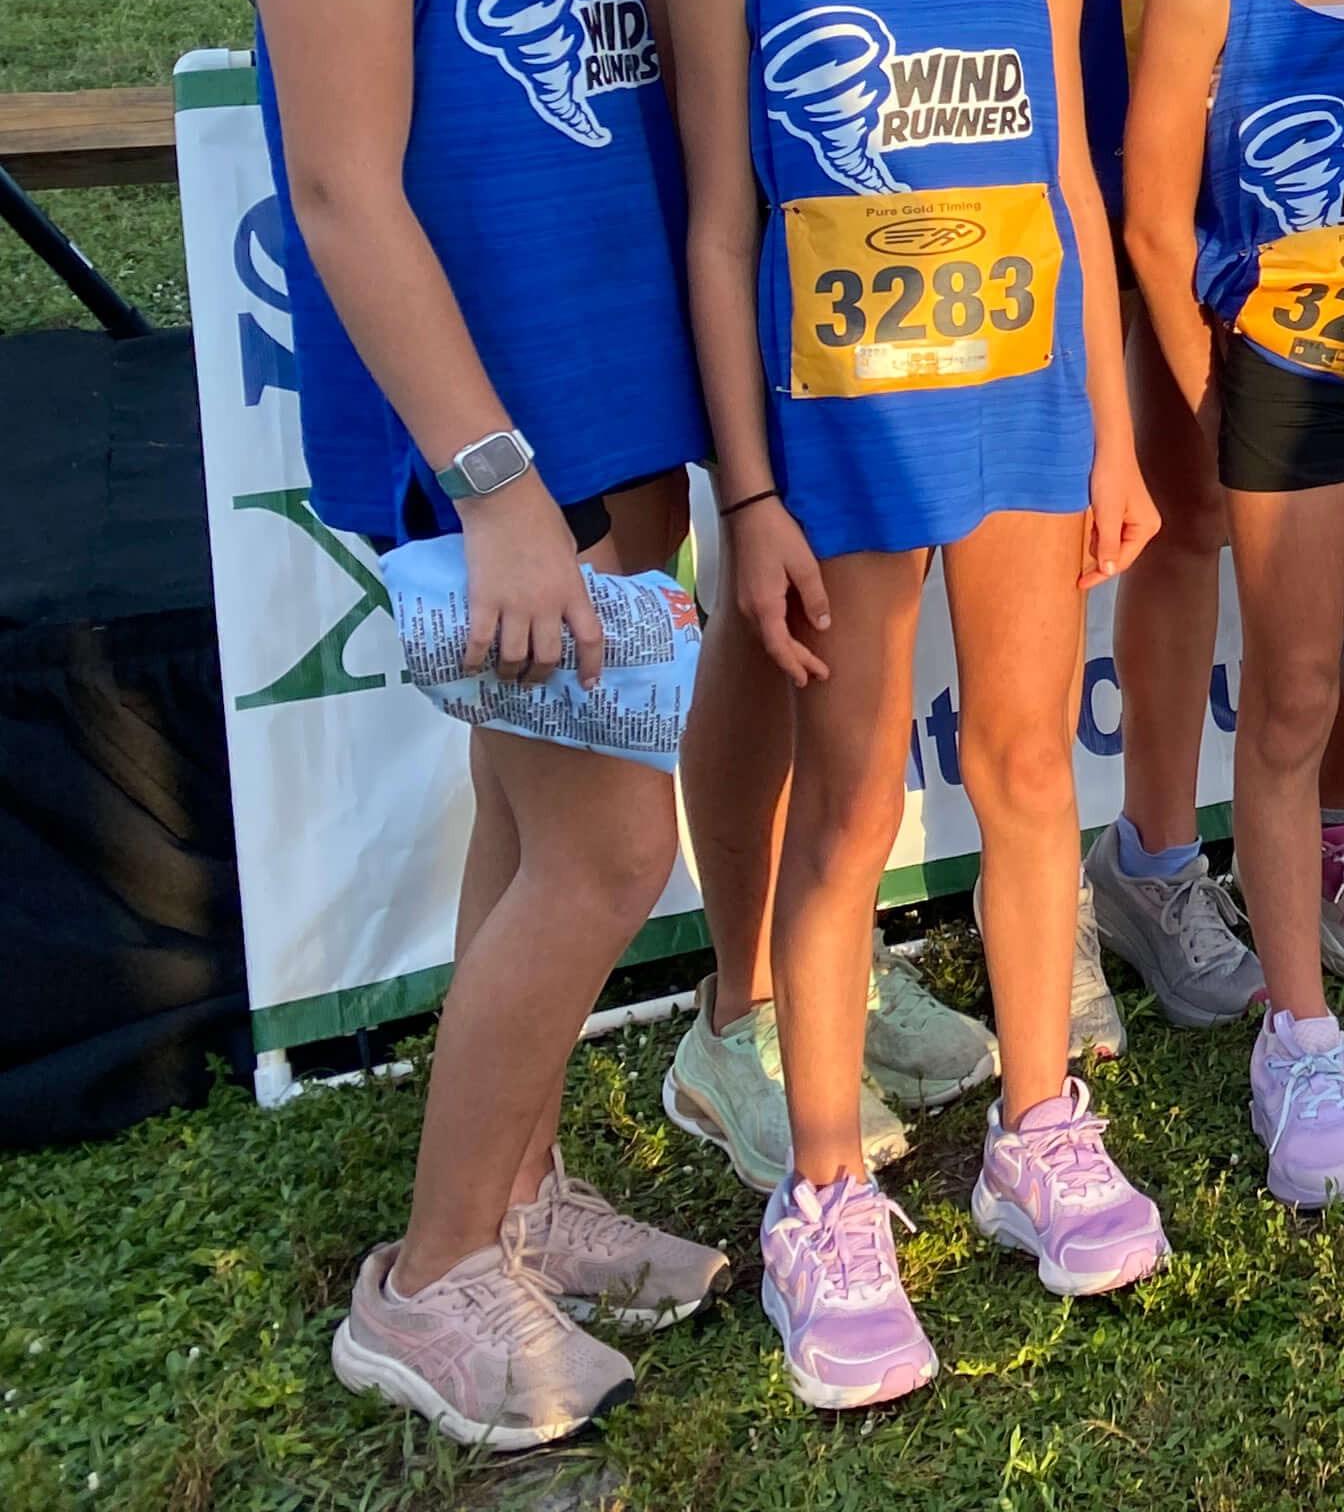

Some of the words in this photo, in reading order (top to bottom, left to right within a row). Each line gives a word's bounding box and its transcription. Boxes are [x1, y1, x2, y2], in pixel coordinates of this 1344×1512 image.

[890, 52, 1022, 109] WIND
[881, 98, 1032, 147] RUNNERS
[865, 207, 898, 218] Pure
[902, 203, 934, 215] Gold
[938, 201, 982, 214] Timing
[814, 255, 1036, 348] 3283
